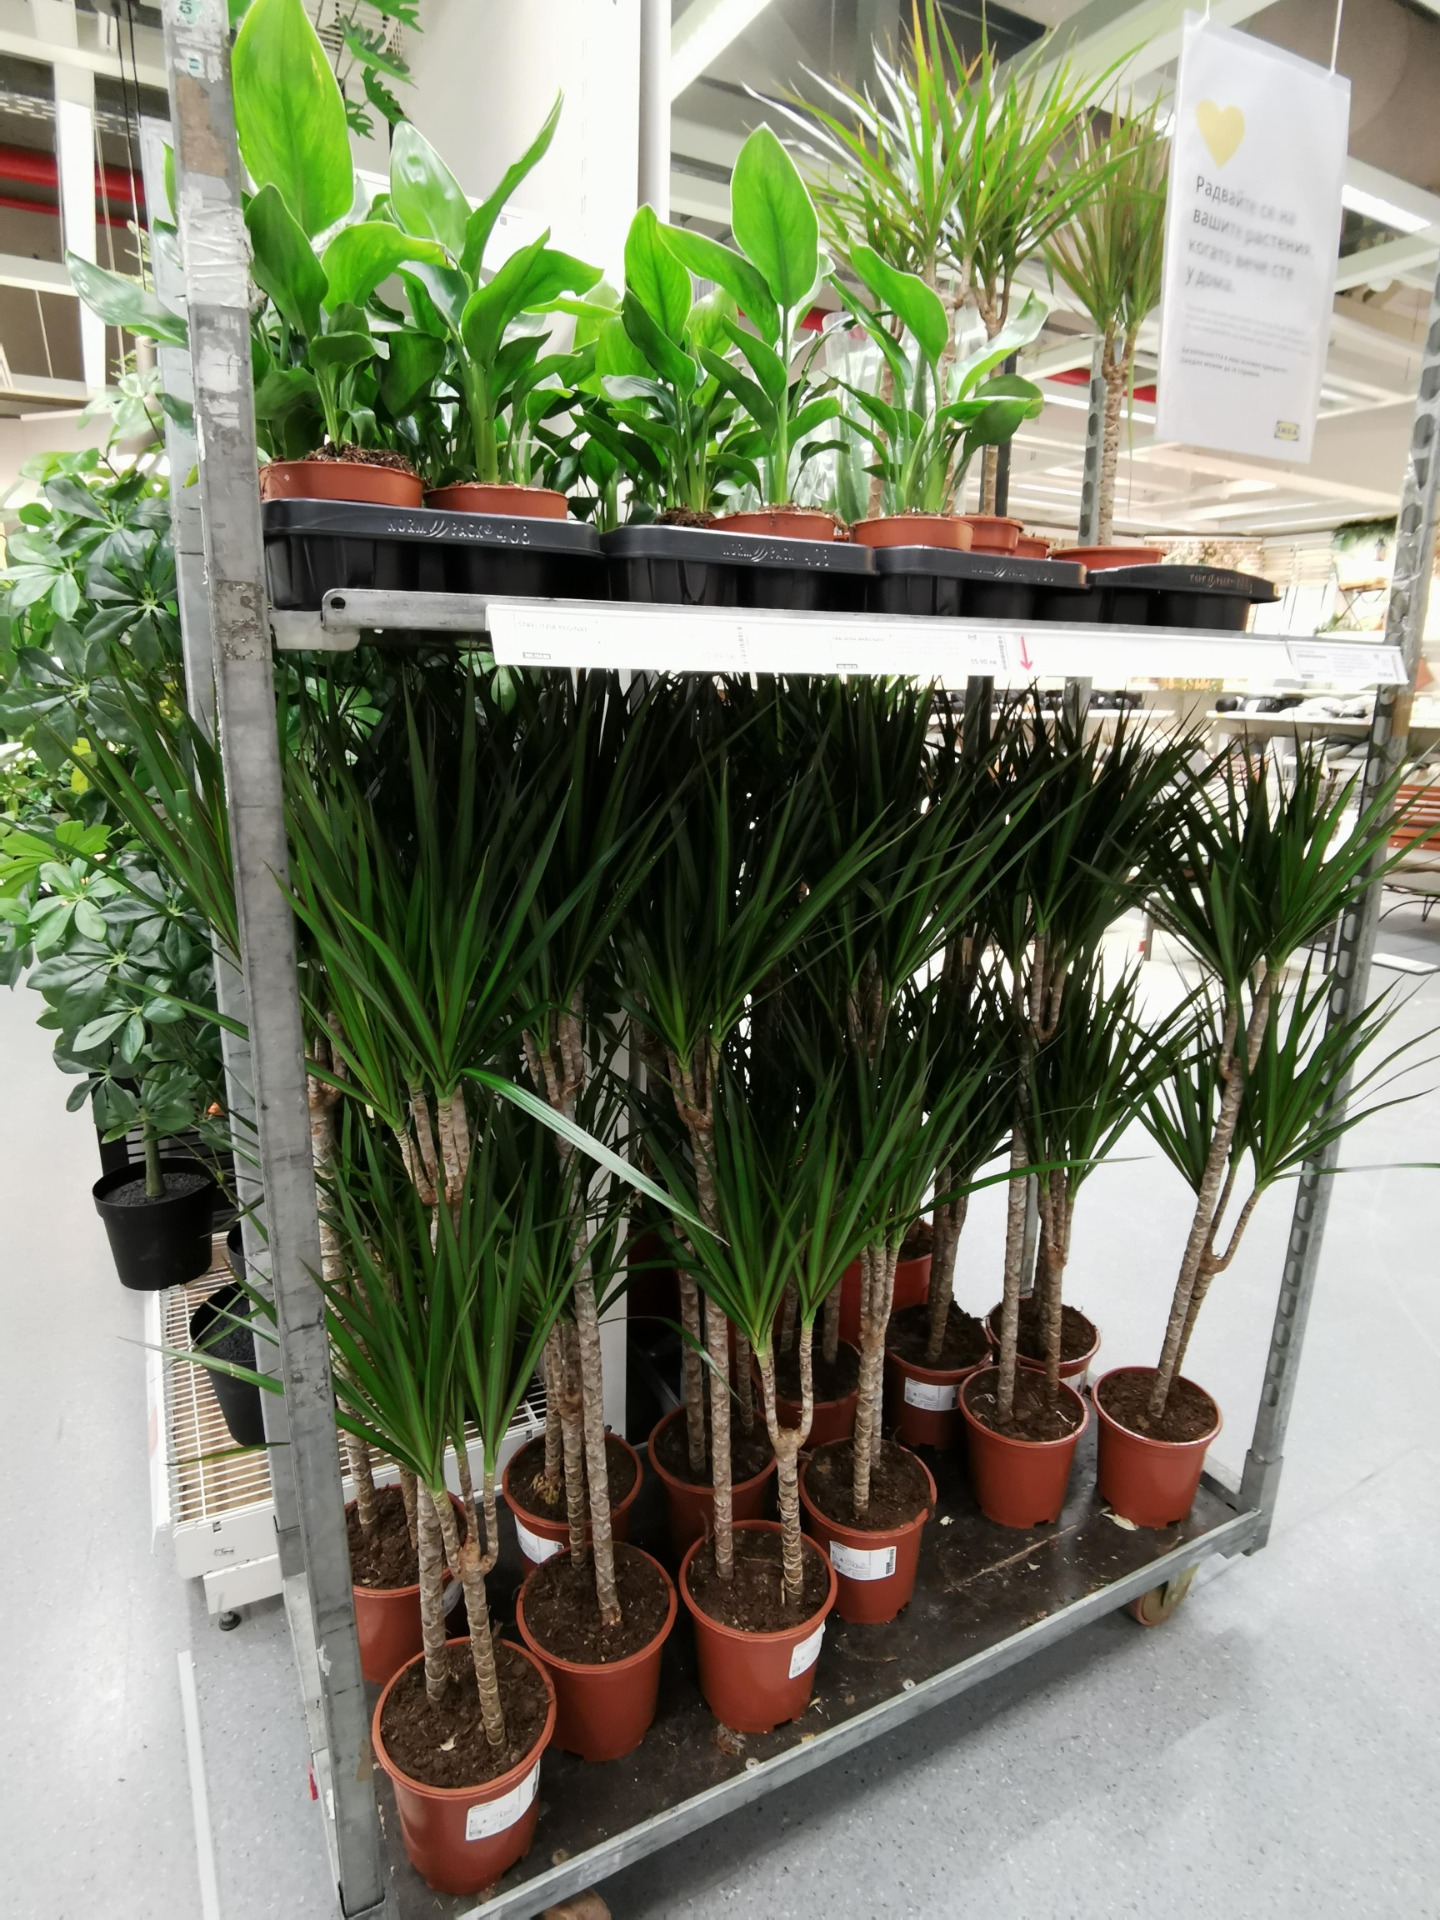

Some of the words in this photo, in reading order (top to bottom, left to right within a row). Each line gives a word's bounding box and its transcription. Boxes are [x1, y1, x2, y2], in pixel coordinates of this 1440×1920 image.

[1196, 175, 1257, 216] Радвайте
[1260, 204, 1276, 220] се
[1279, 208, 1296, 226] на
[1193, 209, 1243, 238] вашите
[1185, 265, 1194, 286] у
[1188, 238, 1232, 265] когато
[1235, 254, 1268, 274] вече
[1271, 263, 1296, 282] сте
